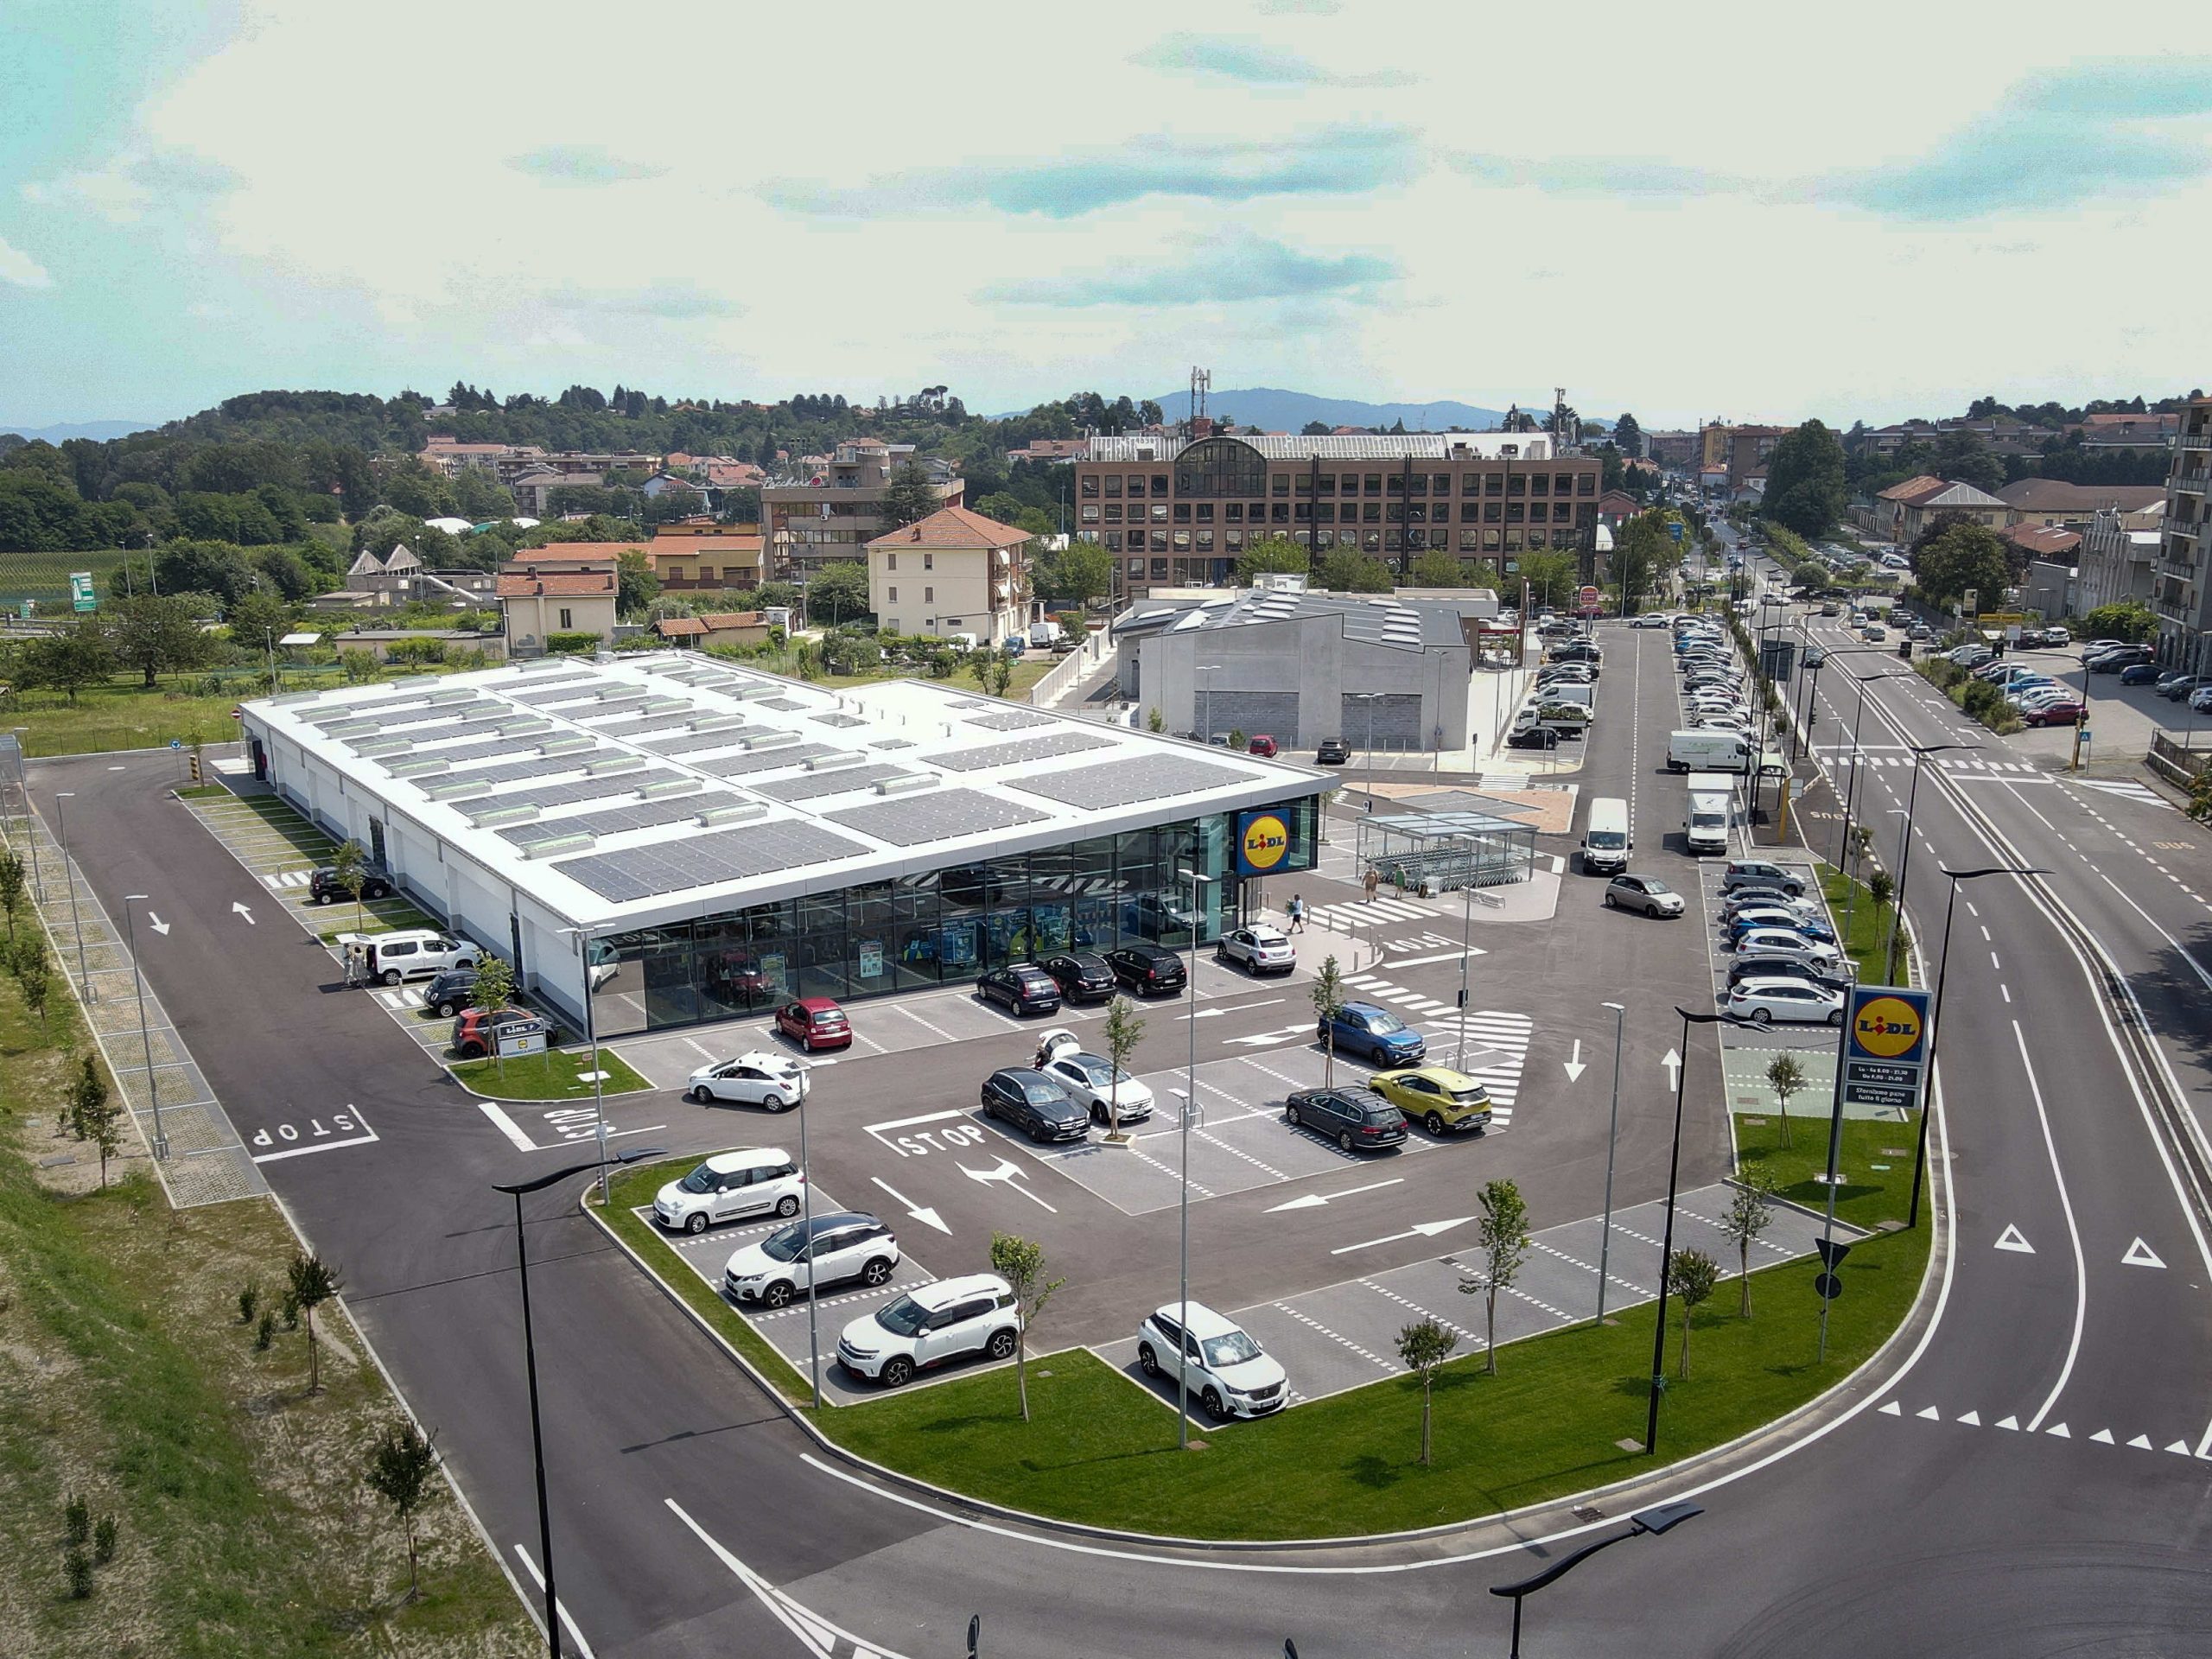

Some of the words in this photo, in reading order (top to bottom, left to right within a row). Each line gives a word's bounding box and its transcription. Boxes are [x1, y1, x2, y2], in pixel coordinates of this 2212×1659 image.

[1809, 811, 1845, 820] BUS
[1382, 935, 1451, 952] STOP
[253, 1115, 355, 1146] STOP
[543, 1108, 617, 1139] STOP
[897, 1124, 986, 1155] STOP
